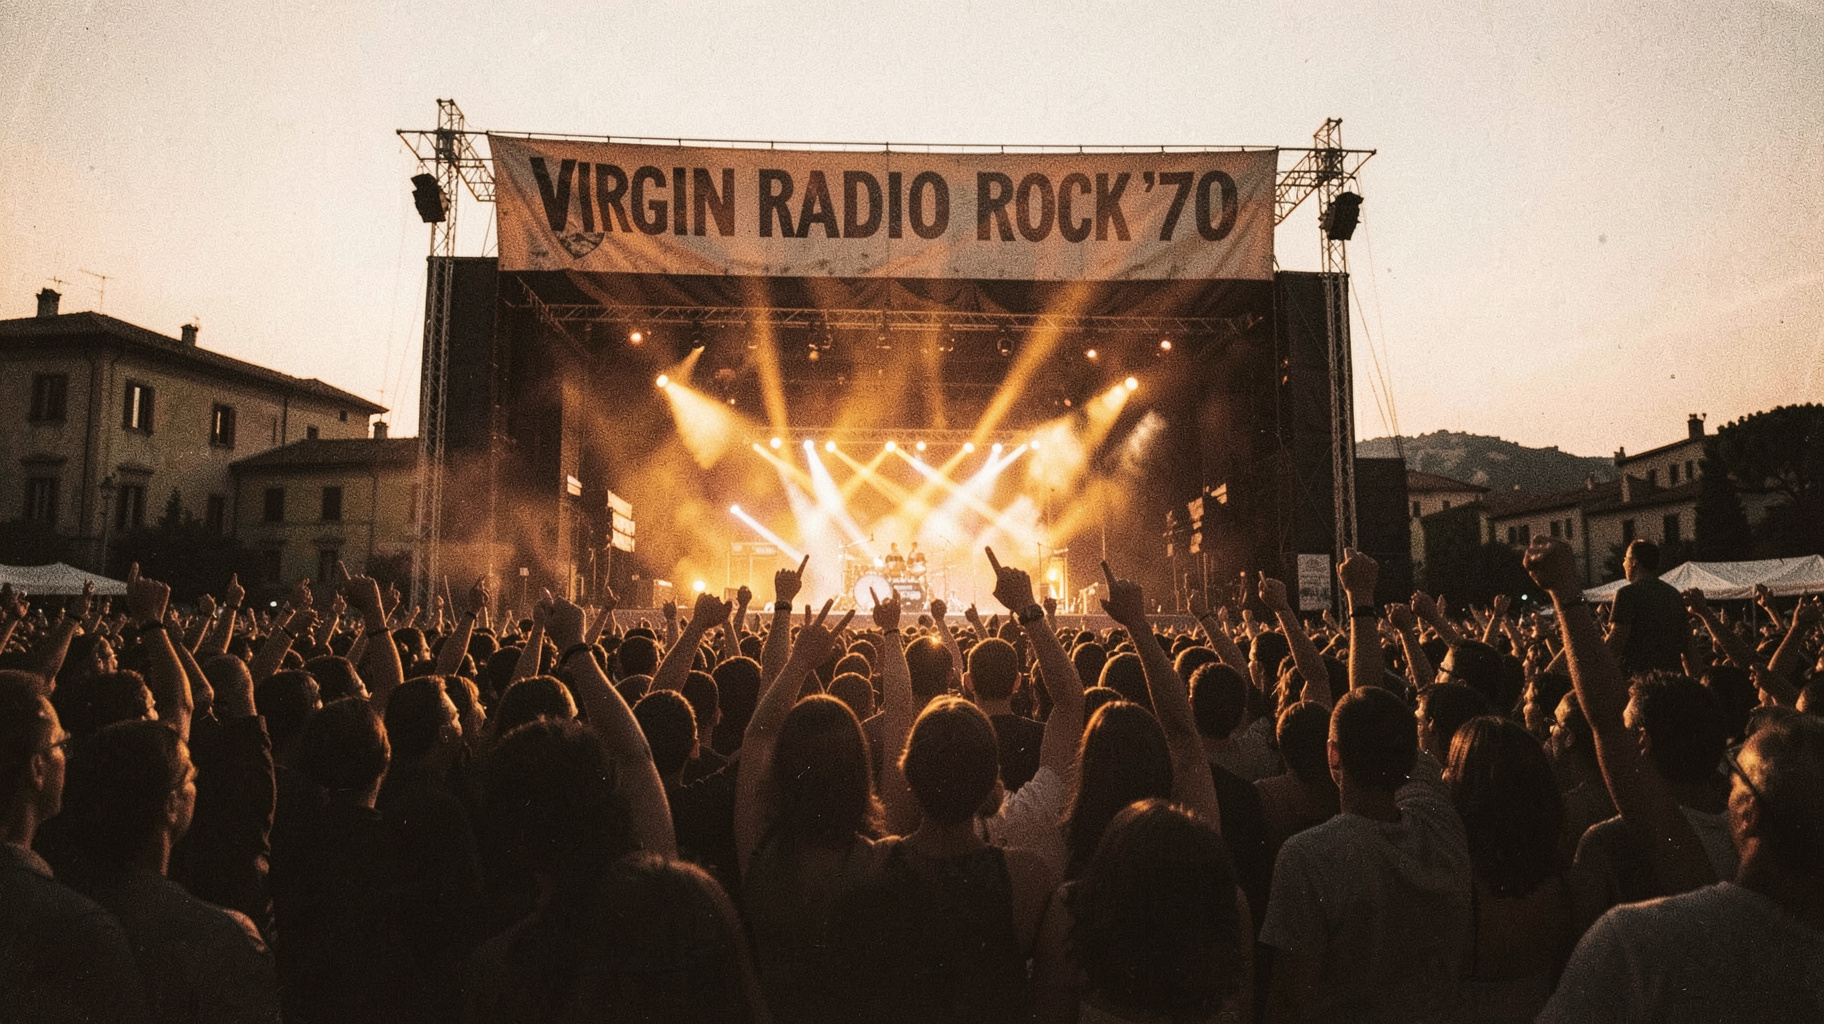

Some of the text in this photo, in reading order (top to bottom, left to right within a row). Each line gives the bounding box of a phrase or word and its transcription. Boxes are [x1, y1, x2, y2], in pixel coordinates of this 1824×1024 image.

[529, 156, 1239, 243] VIRGIN RADIO ROCK '70
